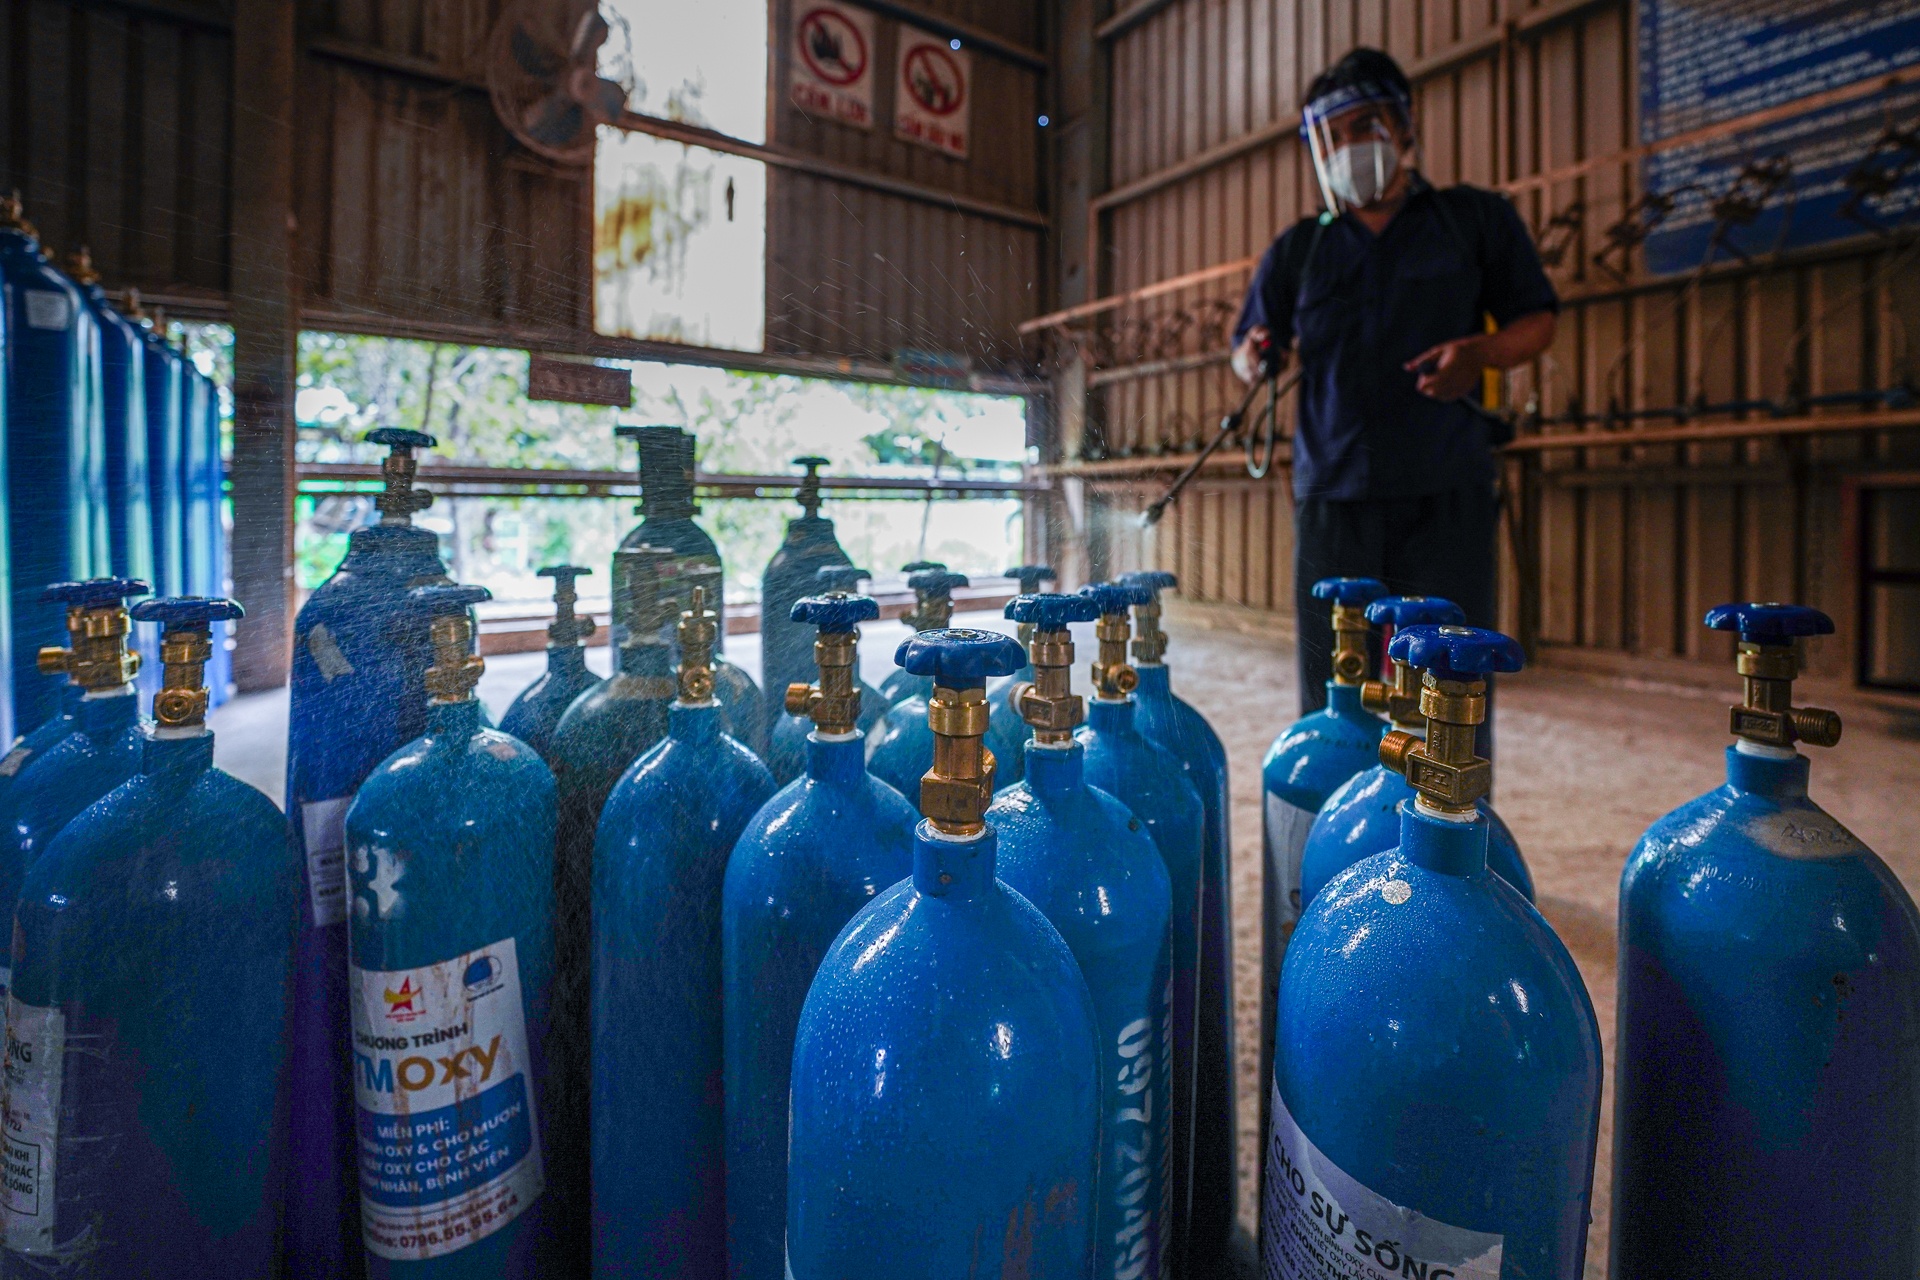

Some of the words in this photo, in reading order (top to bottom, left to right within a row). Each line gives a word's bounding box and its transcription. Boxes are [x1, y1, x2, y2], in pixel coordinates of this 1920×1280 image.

[411, 1022, 468, 1048] TRÌNH
[415, 1115, 451, 1137] PHÍ:
[15, 1149, 29, 1162] KHI
[385, 1144, 413, 1158] OXY
[417, 1143, 429, 1155] &
[432, 1130, 470, 1151] CHO
[384, 1162, 412, 1175] OXY
[415, 1156, 452, 1174] CHO
[1274, 1134, 1306, 1196] CHO
[1310, 1191, 1350, 1239] SỰ
[1290, 1219, 1324, 1266] KHÔNG
[1330, 1251, 1347, 1270] OXY
